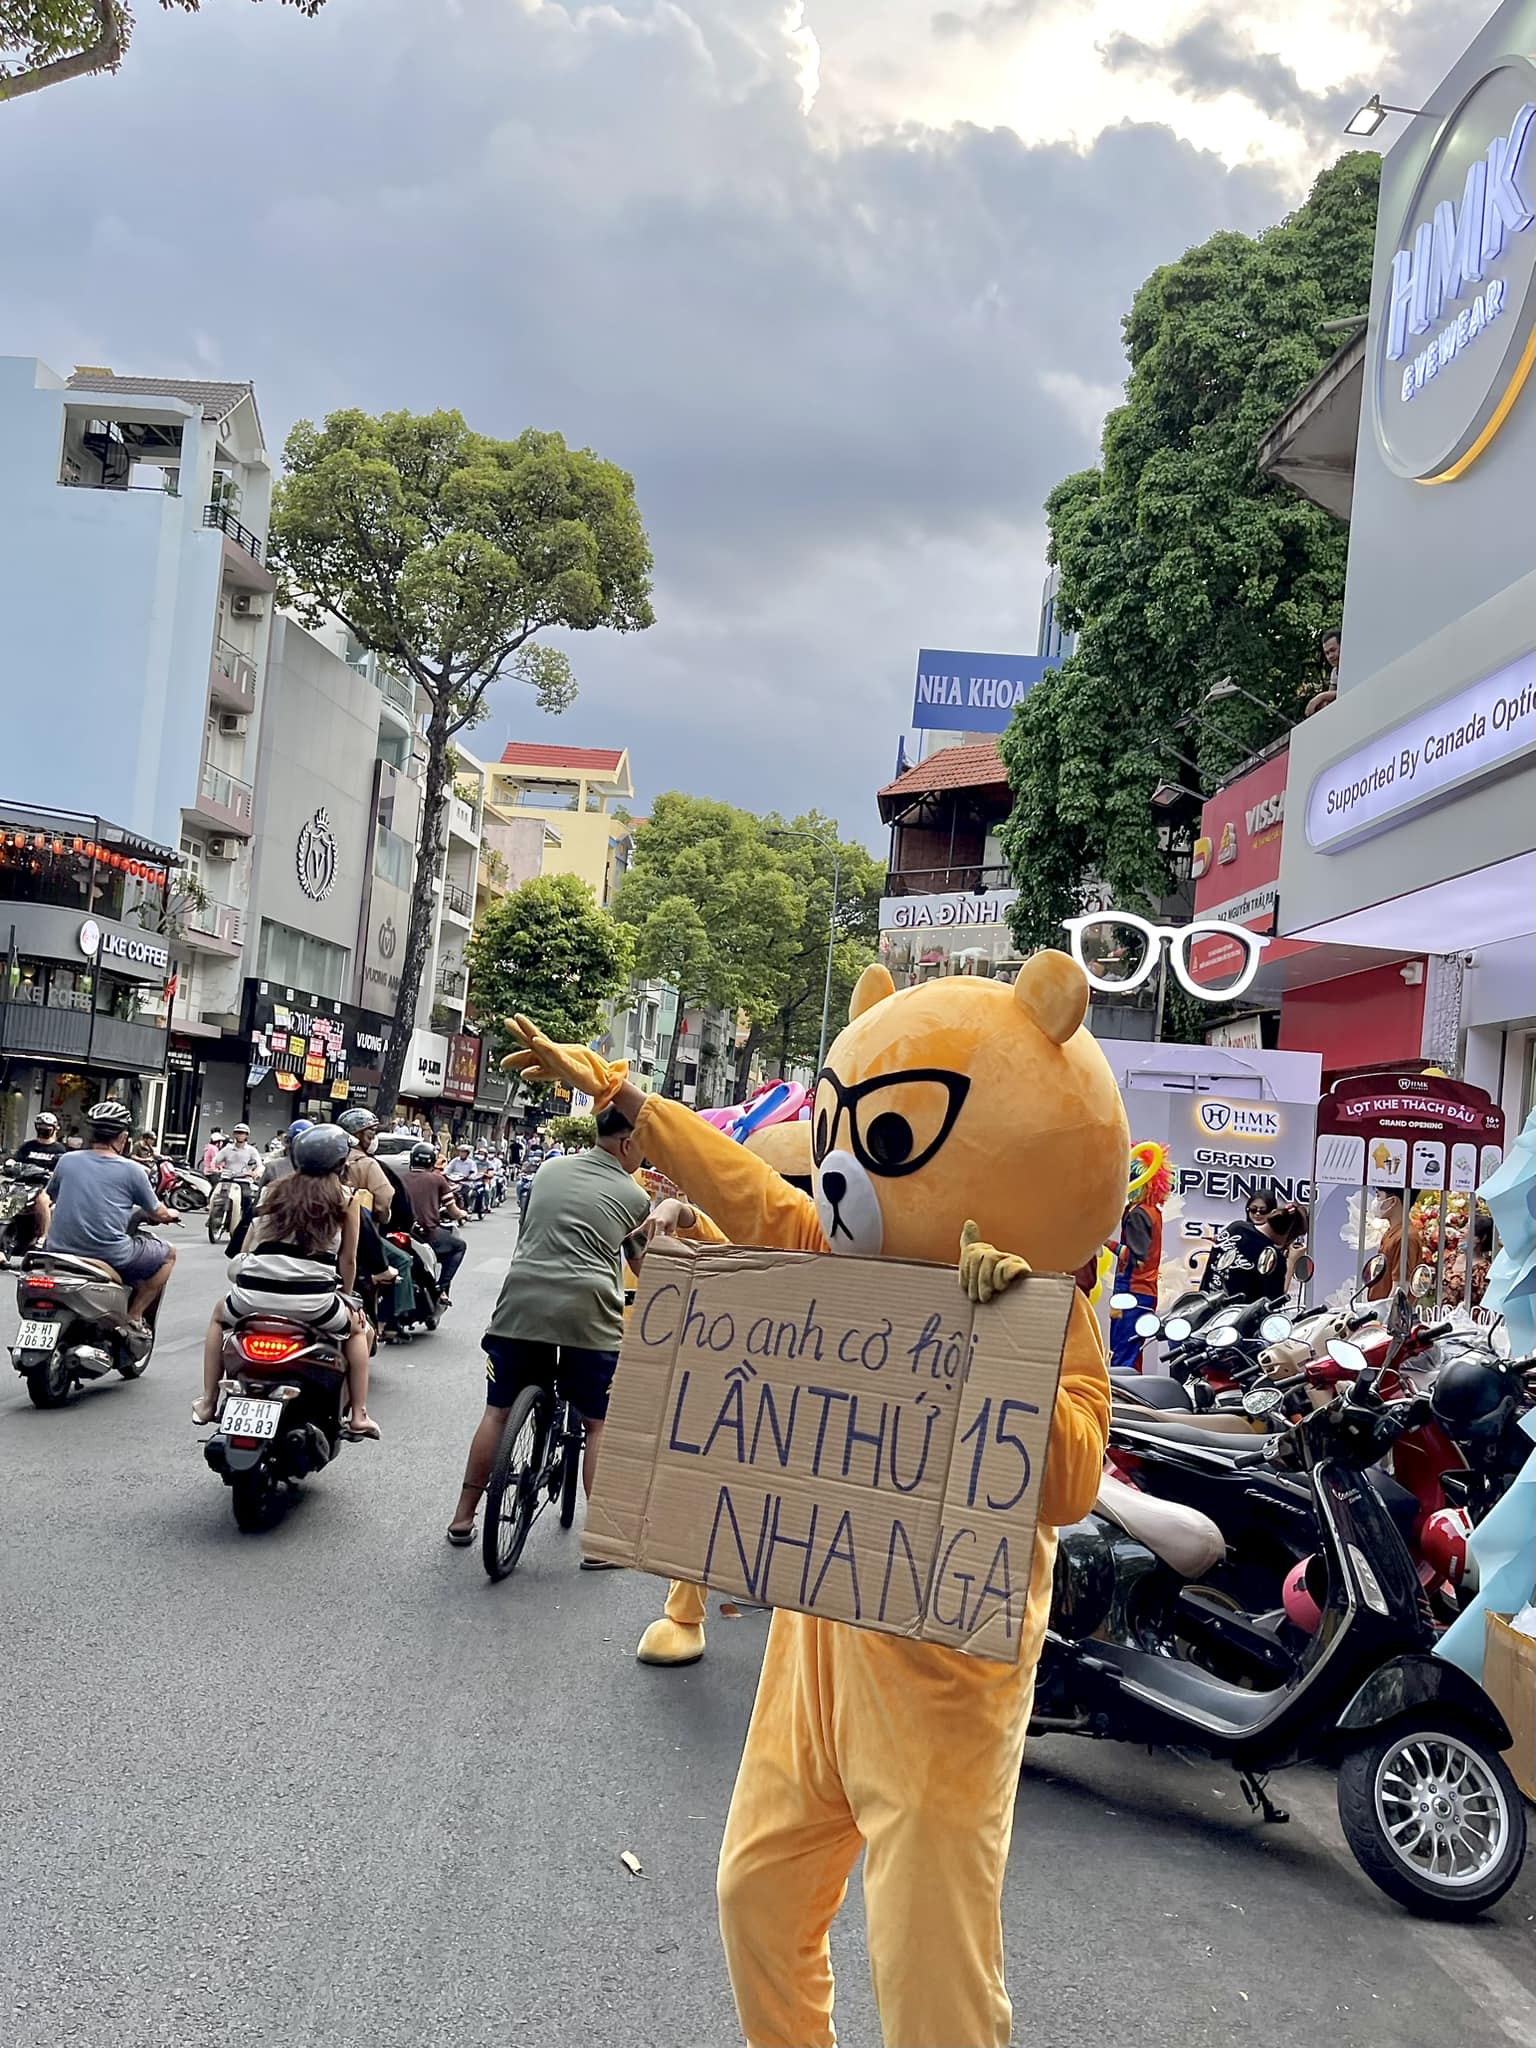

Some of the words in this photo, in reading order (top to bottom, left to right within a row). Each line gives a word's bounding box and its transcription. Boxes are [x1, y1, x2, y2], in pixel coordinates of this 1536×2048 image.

[1386, 102, 1536, 361] HMK
[1401, 279, 1505, 402] EYEWEAR
[917, 674, 963, 706] NHA
[967, 677, 1025, 710] KHOA
[1326, 757, 1396, 815] Supported
[1399, 749, 1421, 780] By
[1424, 712, 1487, 765] Canada
[893, 904, 933, 929] GIA
[935, 896, 998, 927] ĐÌNH
[102, 932, 128, 957] LIKE
[127, 940, 169, 968] COFFEE
[1234, 1110, 1278, 1128] HMK
[1346, 1101, 1371, 1116] LỌT
[1373, 1099, 1399, 1110] KHE
[1401, 1098, 1446, 1115] THÁCH
[1379, 1119, 1407, 1128] GRAND
[1408, 1120, 1444, 1130] OPENING
[1196, 1149, 1276, 1168] GRAND
[1171, 1168, 1320, 1205] PENING
[639, 1283, 735, 1352] Cho
[746, 1298, 824, 1362] anh
[837, 1317, 894, 1371] cơ
[907, 1312, 980, 1392] hội
[223, 1416, 274, 1436] 385.83
[233, 1400, 272, 1419] 78-H1
[668, 1359, 800, 1467] LẦN
[807, 1390, 942, 1492] THỨ
[960, 1397, 1040, 1511] 15
[702, 1485, 863, 1621] NHA
[878, 1519, 1013, 1640] NGA
